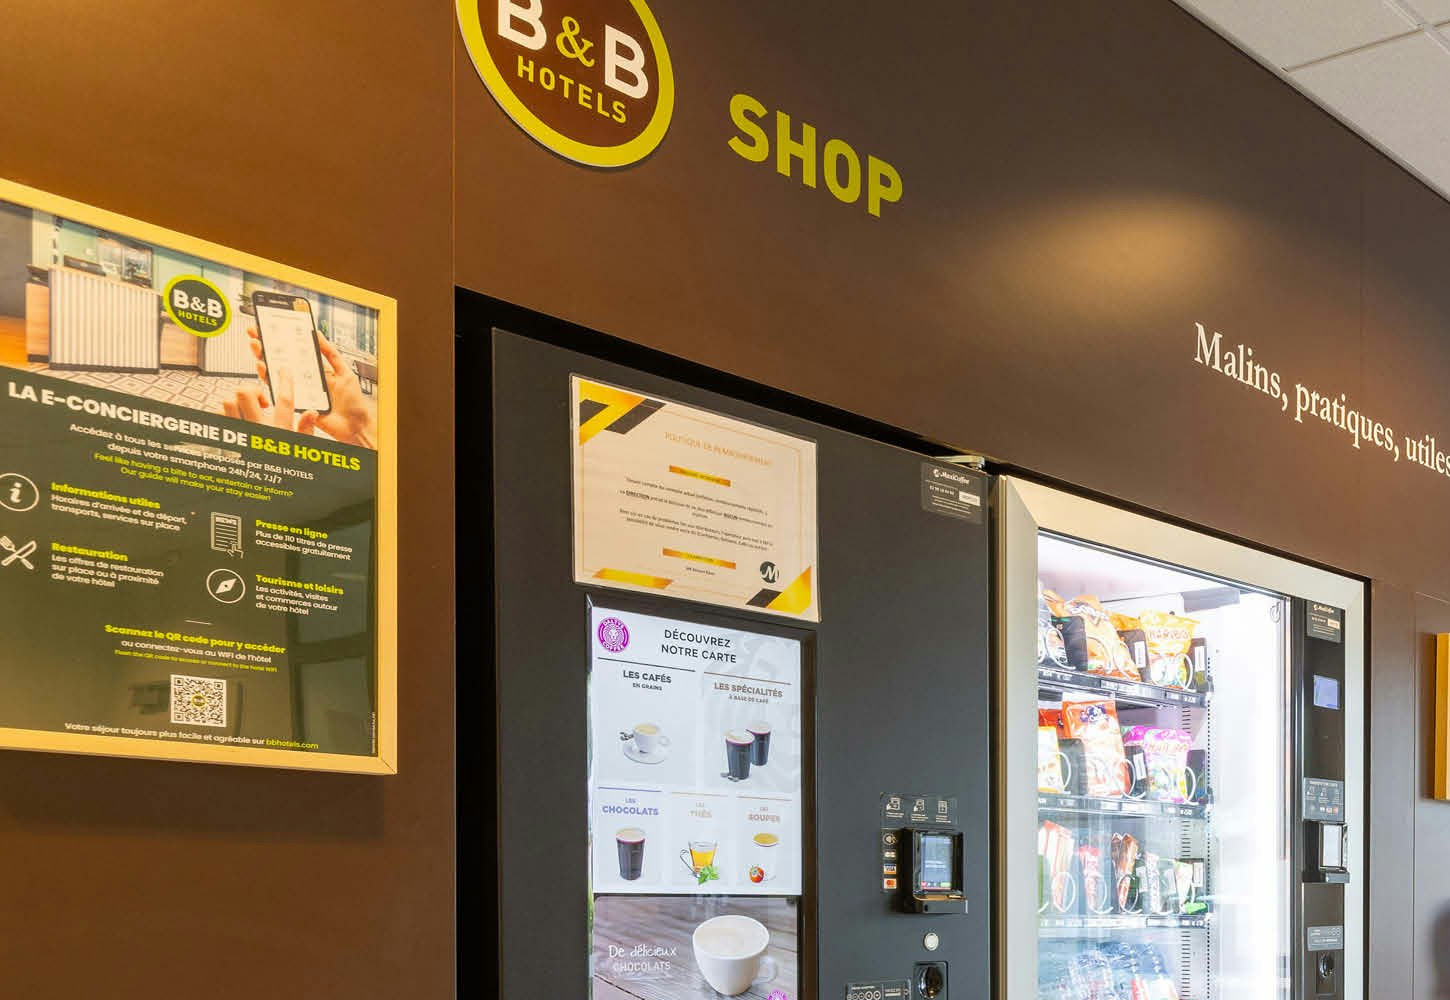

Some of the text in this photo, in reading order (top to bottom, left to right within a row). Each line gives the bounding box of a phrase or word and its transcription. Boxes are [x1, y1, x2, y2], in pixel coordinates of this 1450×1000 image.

[516, 54, 627, 125] HOTELS
[727, 93, 903, 218] SHOP
[172, 289, 224, 319] B&B
[178, 308, 218, 328] HOTELS
[1193, 321, 1288, 412] Malins,
[1294, 382, 1400, 462] pratiques,
[9, 382, 360, 471] LA E-CONCIERGERIE DE B&B HOTELS
[70, 423, 314, 480] Accédez tous proposés HOTELS
[107, 443, 141, 457] depuis
[143, 452, 168, 463] votre
[170, 457, 226, 474] smartphone
[51, 482, 161, 509] Informations utiles
[255, 519, 329, 539] Presse en ligne
[255, 530, 353, 553] Plus titres presse
[255, 540, 351, 560] accessibles gratuitement
[51, 542, 129, 562] Restauration
[66, 575, 115, 588] votre hôtel
[255, 574, 344, 595] Tourisme et loisirs
[265, 596, 338, 611] commerces autour
[269, 588, 329, 602] activités, visites
[268, 604, 309, 616] votre hôtel
[104, 624, 286, 654] Scannez le QR code pour y accéder
[664, 628, 731, 648] DÉCOUVREZ
[135, 642, 203, 656] connectez-vous
[248, 653, 272, 663] l'hôtel
[661, 644, 737, 663] NOTRE CARTE
[623, 670, 672, 684] LES CAFÉS
[714, 682, 783, 698] LES SPÉCIALITÉS
[65, 722, 319, 750] Votre séjour toujours plus facile agréable bbhotels.com
[602, 805, 659, 816] CHOCOLATS
[608, 944, 625, 958] De
